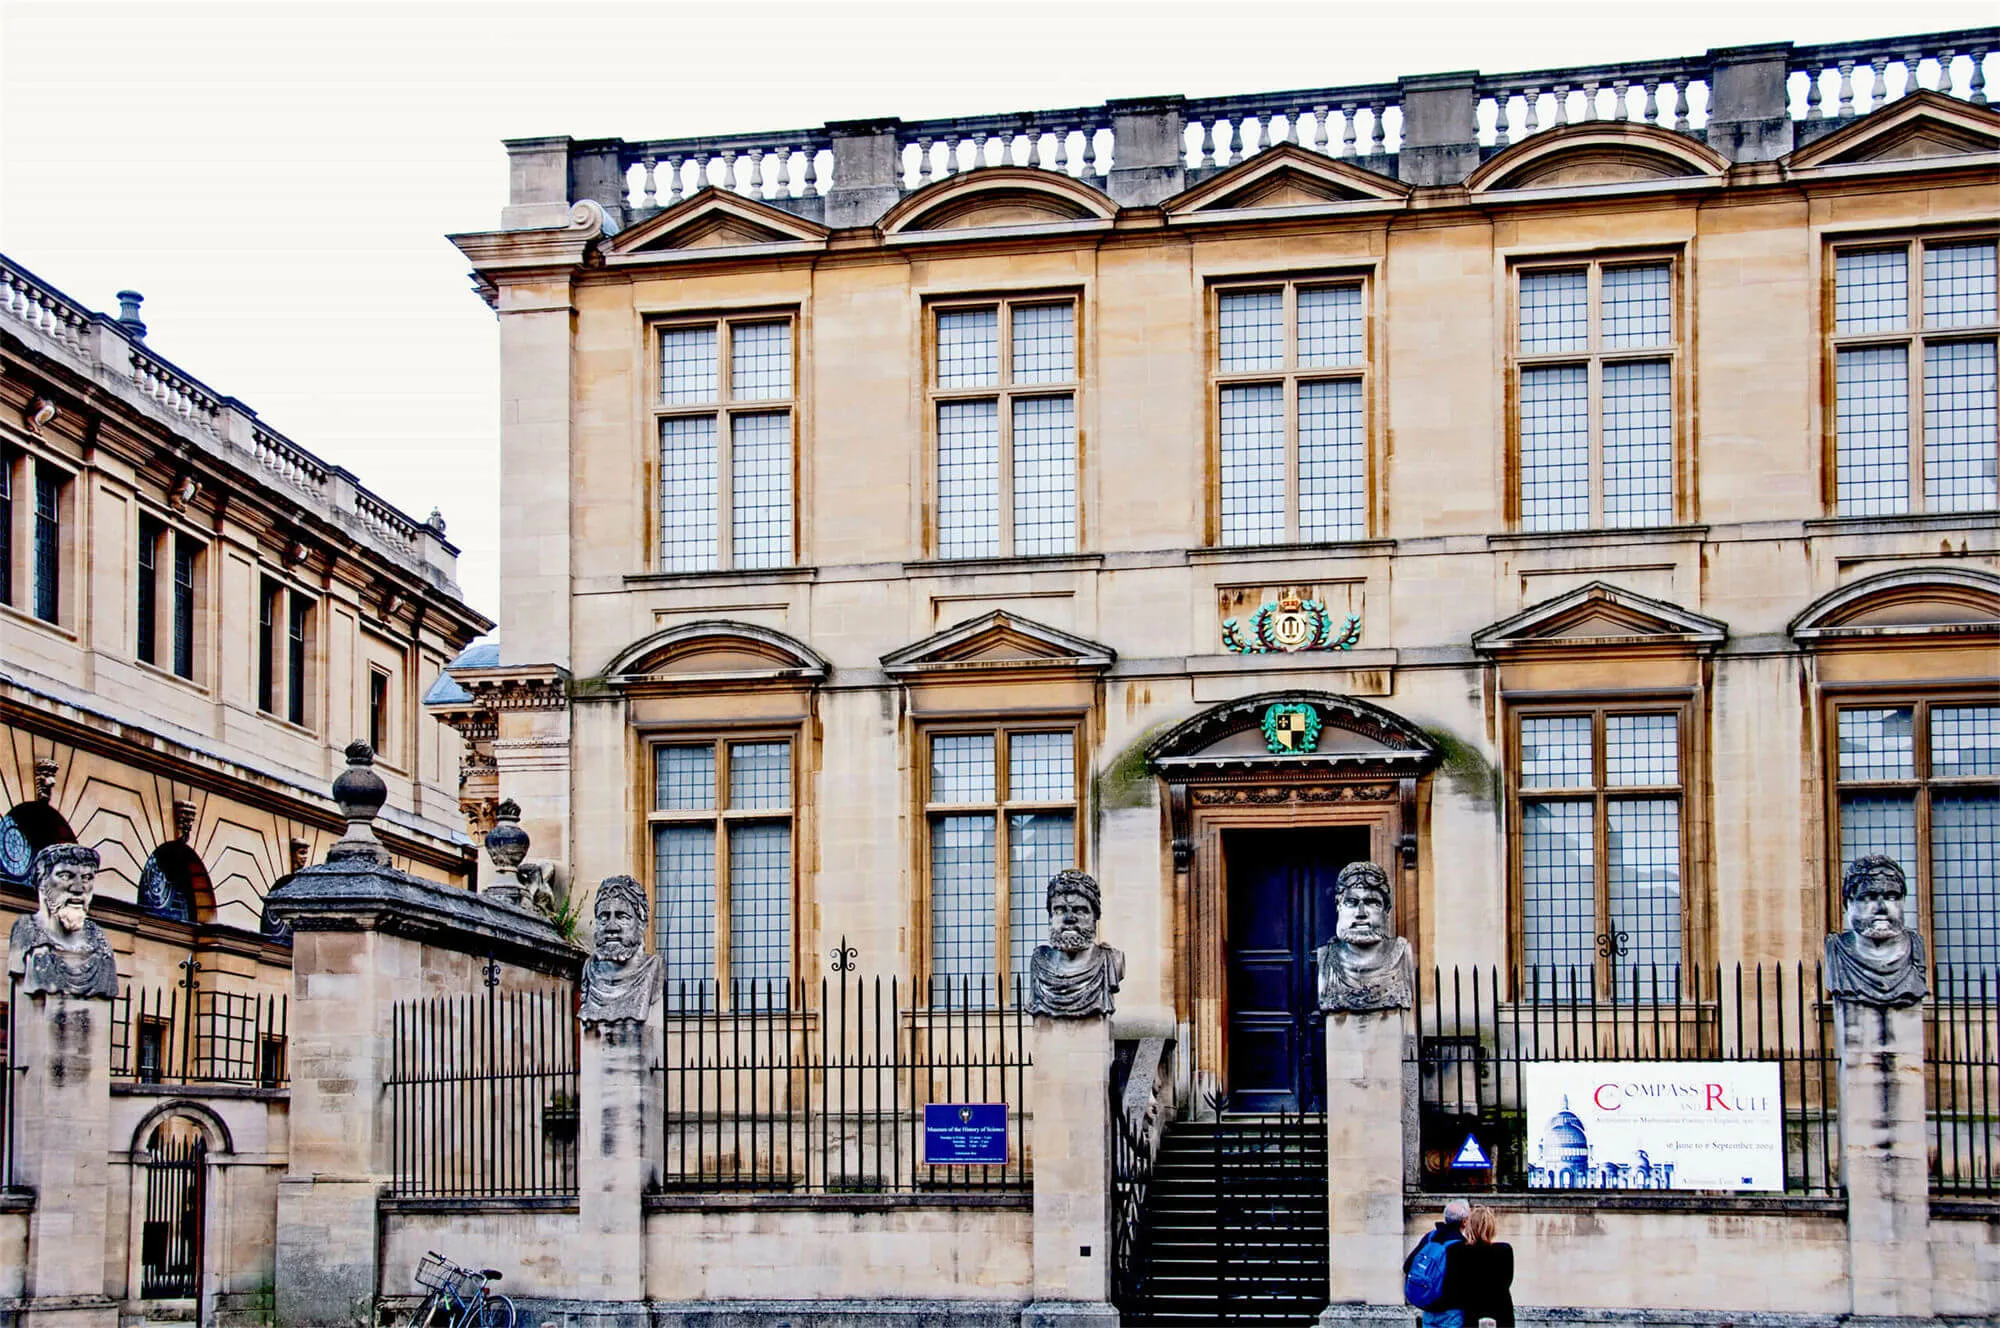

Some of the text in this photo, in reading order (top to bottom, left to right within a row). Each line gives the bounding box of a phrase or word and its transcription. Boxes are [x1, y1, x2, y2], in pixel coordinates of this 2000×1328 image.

[1593, 1083, 1699, 1111] COMPASS
[1675, 1141, 1693, 1150] June
[1712, 1141, 1753, 1150] September
